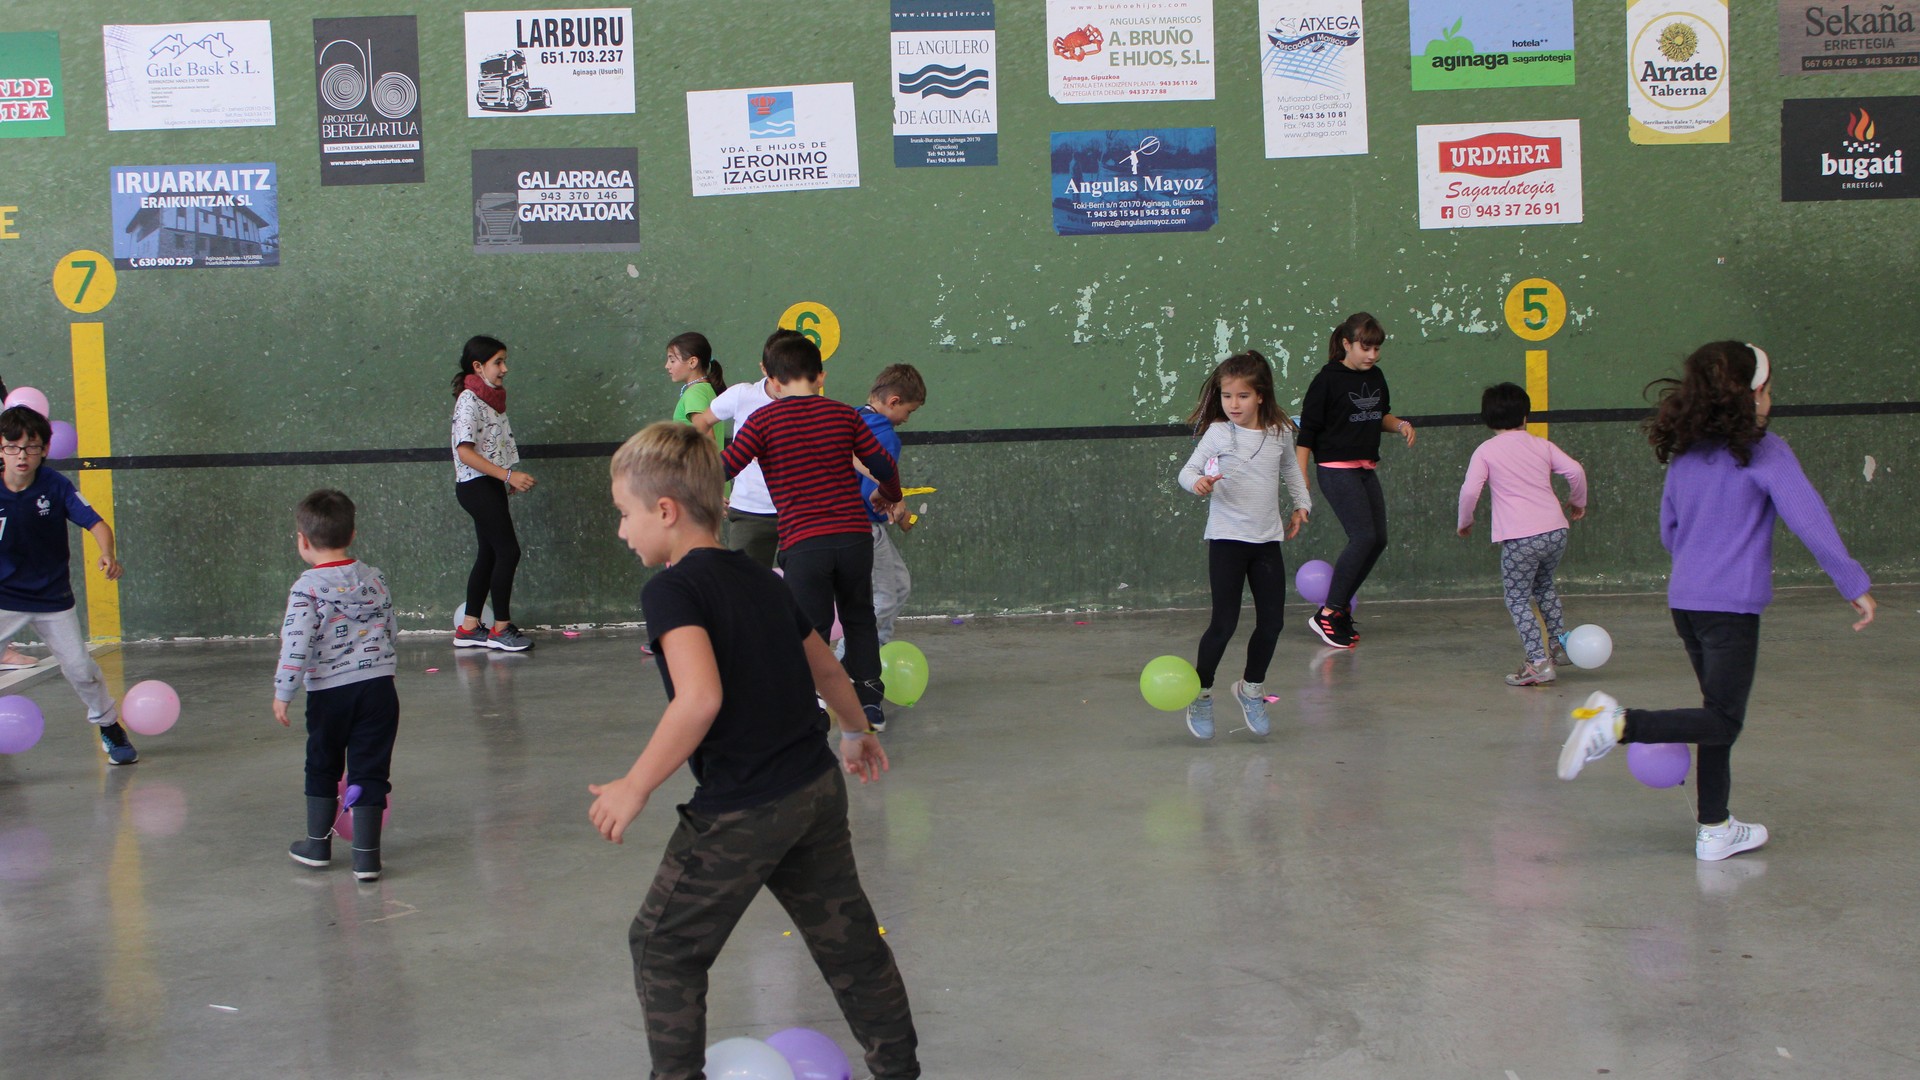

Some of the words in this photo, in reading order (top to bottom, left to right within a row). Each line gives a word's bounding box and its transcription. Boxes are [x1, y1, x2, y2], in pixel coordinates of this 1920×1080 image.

[894, 10, 991, 18] www.elangulero.es
[1109, 17, 1150, 26] ANGULAS
[1151, 16, 1158, 24] Y
[1158, 15, 1202, 24] MARISCOS
[1805, 4, 1916, 37] Sekaña
[1299, 16, 1360, 31] ATXEGA
[516, 16, 624, 48] LARBURU
[1109, 31, 1126, 46] A.
[1129, 26, 1193, 46] BRUÑO
[897, 40, 914, 55] EL
[915, 39, 990, 55] ANGULERO
[1275, 38, 1310, 51] Pescados
[1316, 33, 1348, 46] Mariscos
[1824, 38, 1895, 51] ERRETEGIA
[541, 50, 624, 64] 651.703.237
[1109, 52, 1120, 66] E
[1123, 50, 1177, 67] HIJOS,
[1181, 49, 1210, 64] S.L.
[1431, 53, 1509, 71] aginaga
[1512, 54, 1572, 64] sagardotegia
[1804, 60, 1820, 68] 667
[1822, 59, 1833, 67] 69
[1834, 58, 1845, 66] 47
[1846, 58, 1857, 66] 69
[1865, 57, 1881, 65] 943
[1895, 56, 1905, 64] 27
[1907, 55, 1918, 64] 73
[146, 62, 182, 77] Gale
[187, 61, 224, 76] Bask
[229, 60, 261, 75] S.L.
[572, 68, 597, 76] Aginaga
[598, 67, 624, 76] (Usurbil)
[1640, 60, 1718, 82] Arrate
[1090, 74, 1120, 82] Gipuzkoa
[1342, 92, 1351, 100] 17
[1649, 84, 1707, 97] Taberna
[0, 101, 50, 122] TEA
[1277, 104, 1310, 112] Aginaga
[1312, 101, 1353, 111] (Gipuzkoa)
[322, 113, 369, 123] AROZTEGIA
[899, 110, 917, 125] DE
[919, 109, 991, 125] AGUINAGA
[322, 121, 419, 138] BEREZIARTUA
[1283, 129, 1348, 139] www.atxega.com
[720, 146, 749, 154] VDA.
[768, 142, 805, 151] HIJOS
[330, 157, 414, 166] www.aroztegiabereziartua.com
[722, 151, 827, 169] JERONIMO
[1821, 149, 1903, 179] bugati
[117, 169, 271, 194] IRUARKAITZ
[517, 170, 634, 189] GALARRAGA
[724, 166, 828, 184] IZAGUIRRE
[1064, 176, 1138, 198] Angulas
[1143, 175, 1204, 195] Mayoz
[1445, 180, 1556, 202] Sagardotegia
[1841, 181, 1884, 189] ERRETEGIA
[141, 195, 235, 209] ERAIKUNTZAK
[237, 194, 253, 206] SL
[540, 191, 561, 200] 943
[568, 191, 590, 200] 370
[597, 191, 618, 200] 146
[1072, 201, 1105, 209] Toki-Berri
[1106, 201, 1118, 209] s/n
[1118, 200, 1141, 208] 20170
[1141, 200, 1171, 209] Aginaga,
[1172, 199, 1204, 208] Gipuzkoa
[1475, 205, 1500, 217] 943
[1504, 204, 1521, 216] 37
[1525, 203, 1542, 215] 26
[1544, 202, 1560, 214] 91
[518, 202, 635, 222] GARRAIOAK
[1129, 209, 1139, 217] 94
[1145, 209, 1159, 217] 943
[1170, 208, 1179, 216] 61
[1091, 218, 1186, 228] mayoz@angulasmayoz.com
[138, 258, 156, 266] 630
[157, 258, 175, 266] 900
[175, 257, 193, 266] 279
[71, 260, 97, 304] 7
[1523, 287, 1548, 330] 5
[796, 311, 822, 349] 6
